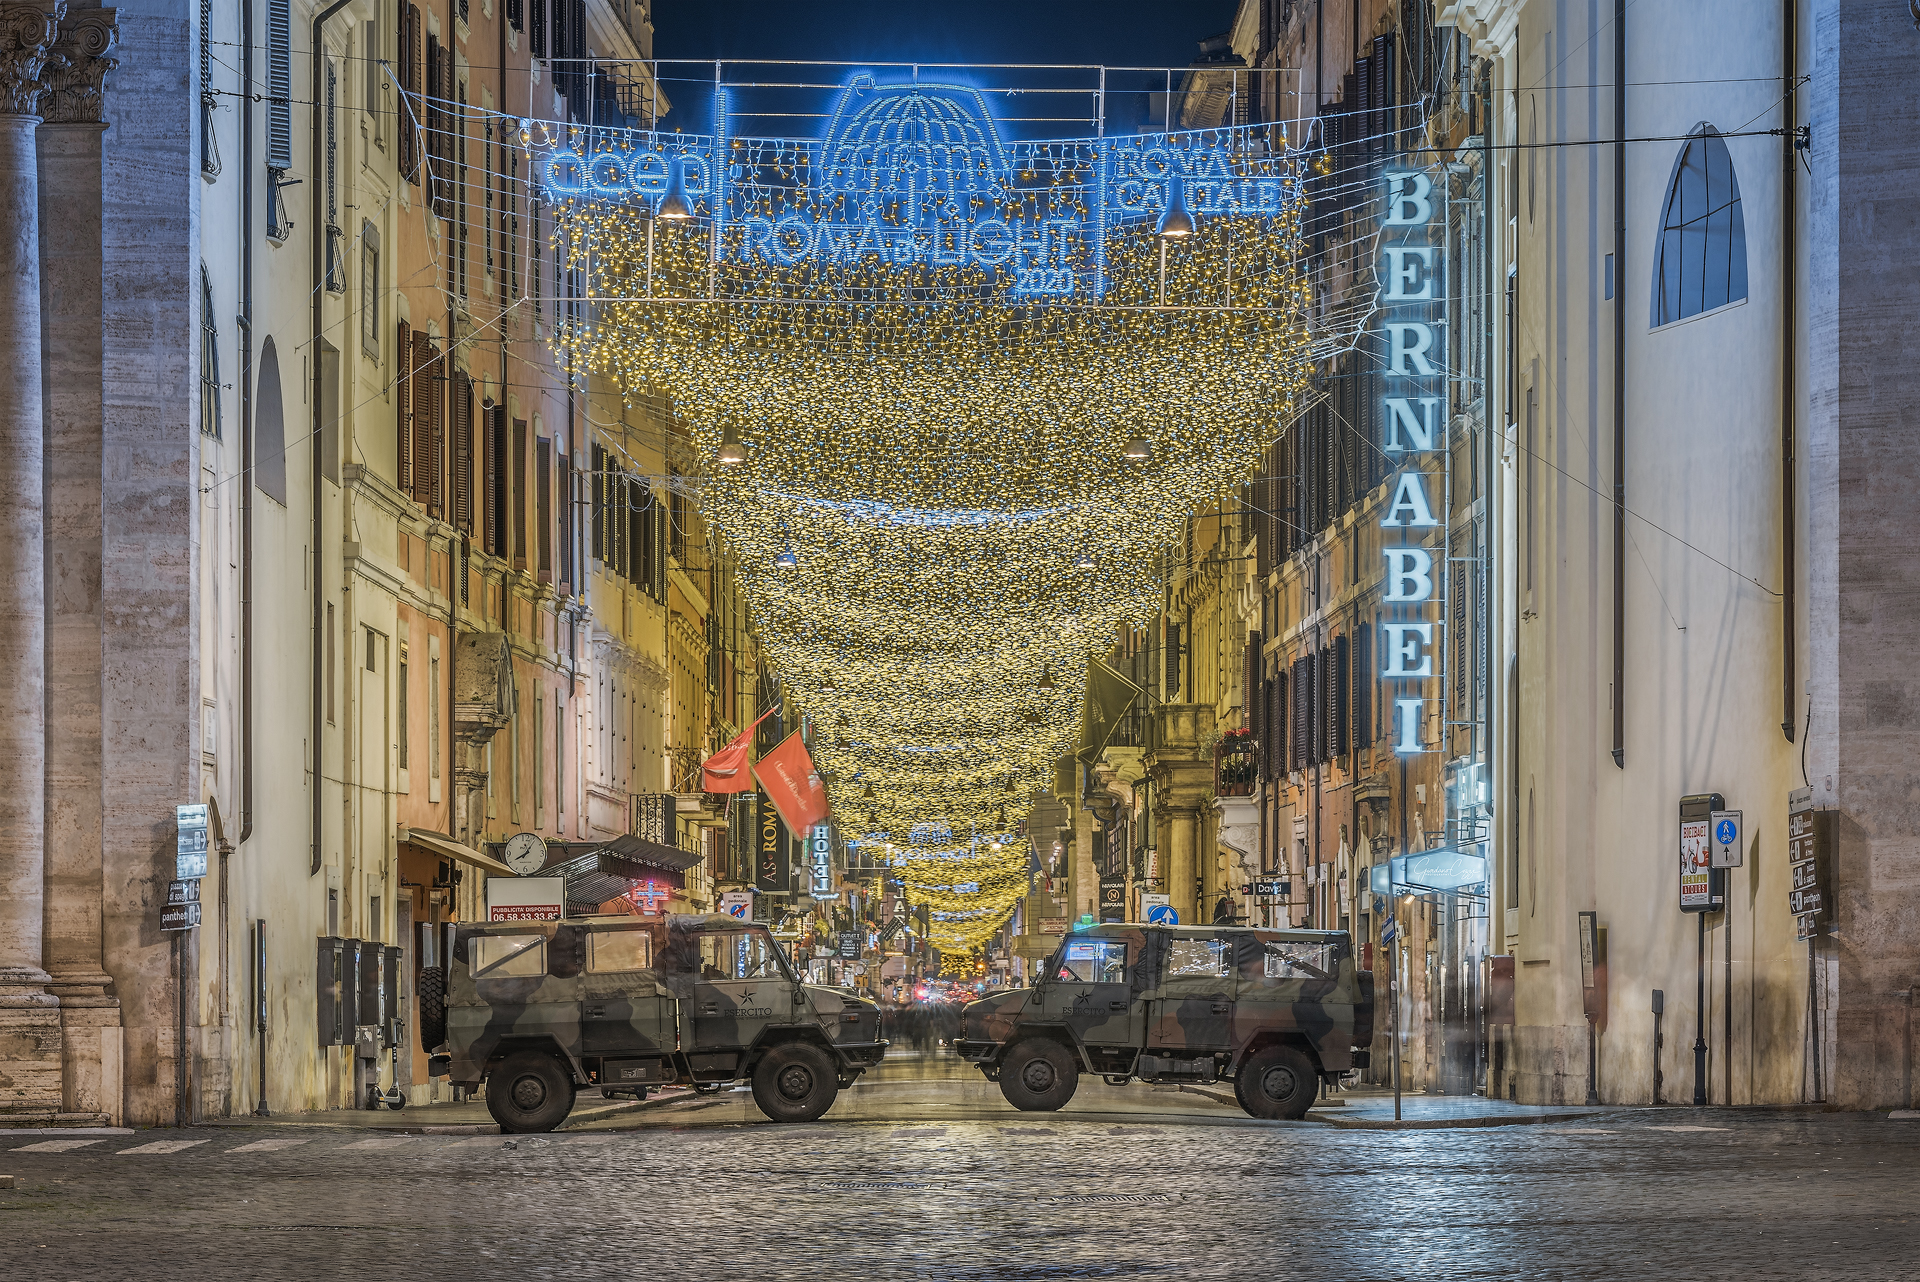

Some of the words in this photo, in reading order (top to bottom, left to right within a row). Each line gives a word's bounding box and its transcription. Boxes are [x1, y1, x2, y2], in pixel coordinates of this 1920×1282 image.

[1117, 148, 1231, 178] ROMA
[744, 216, 891, 264] ROMA
[933, 217, 1080, 265] LIGHT
[1015, 267, 1074, 294] 2020
[1381, 171, 1438, 753] BERNABEI
[1683, 825, 1706, 839] BICIBACI
[1684, 876, 1705, 885] RENTAL
[1258, 884, 1282, 893] Davd
[724, 1007, 773, 1018] ESERCITO
[1062, 1006, 1106, 1016] ESERCITO
